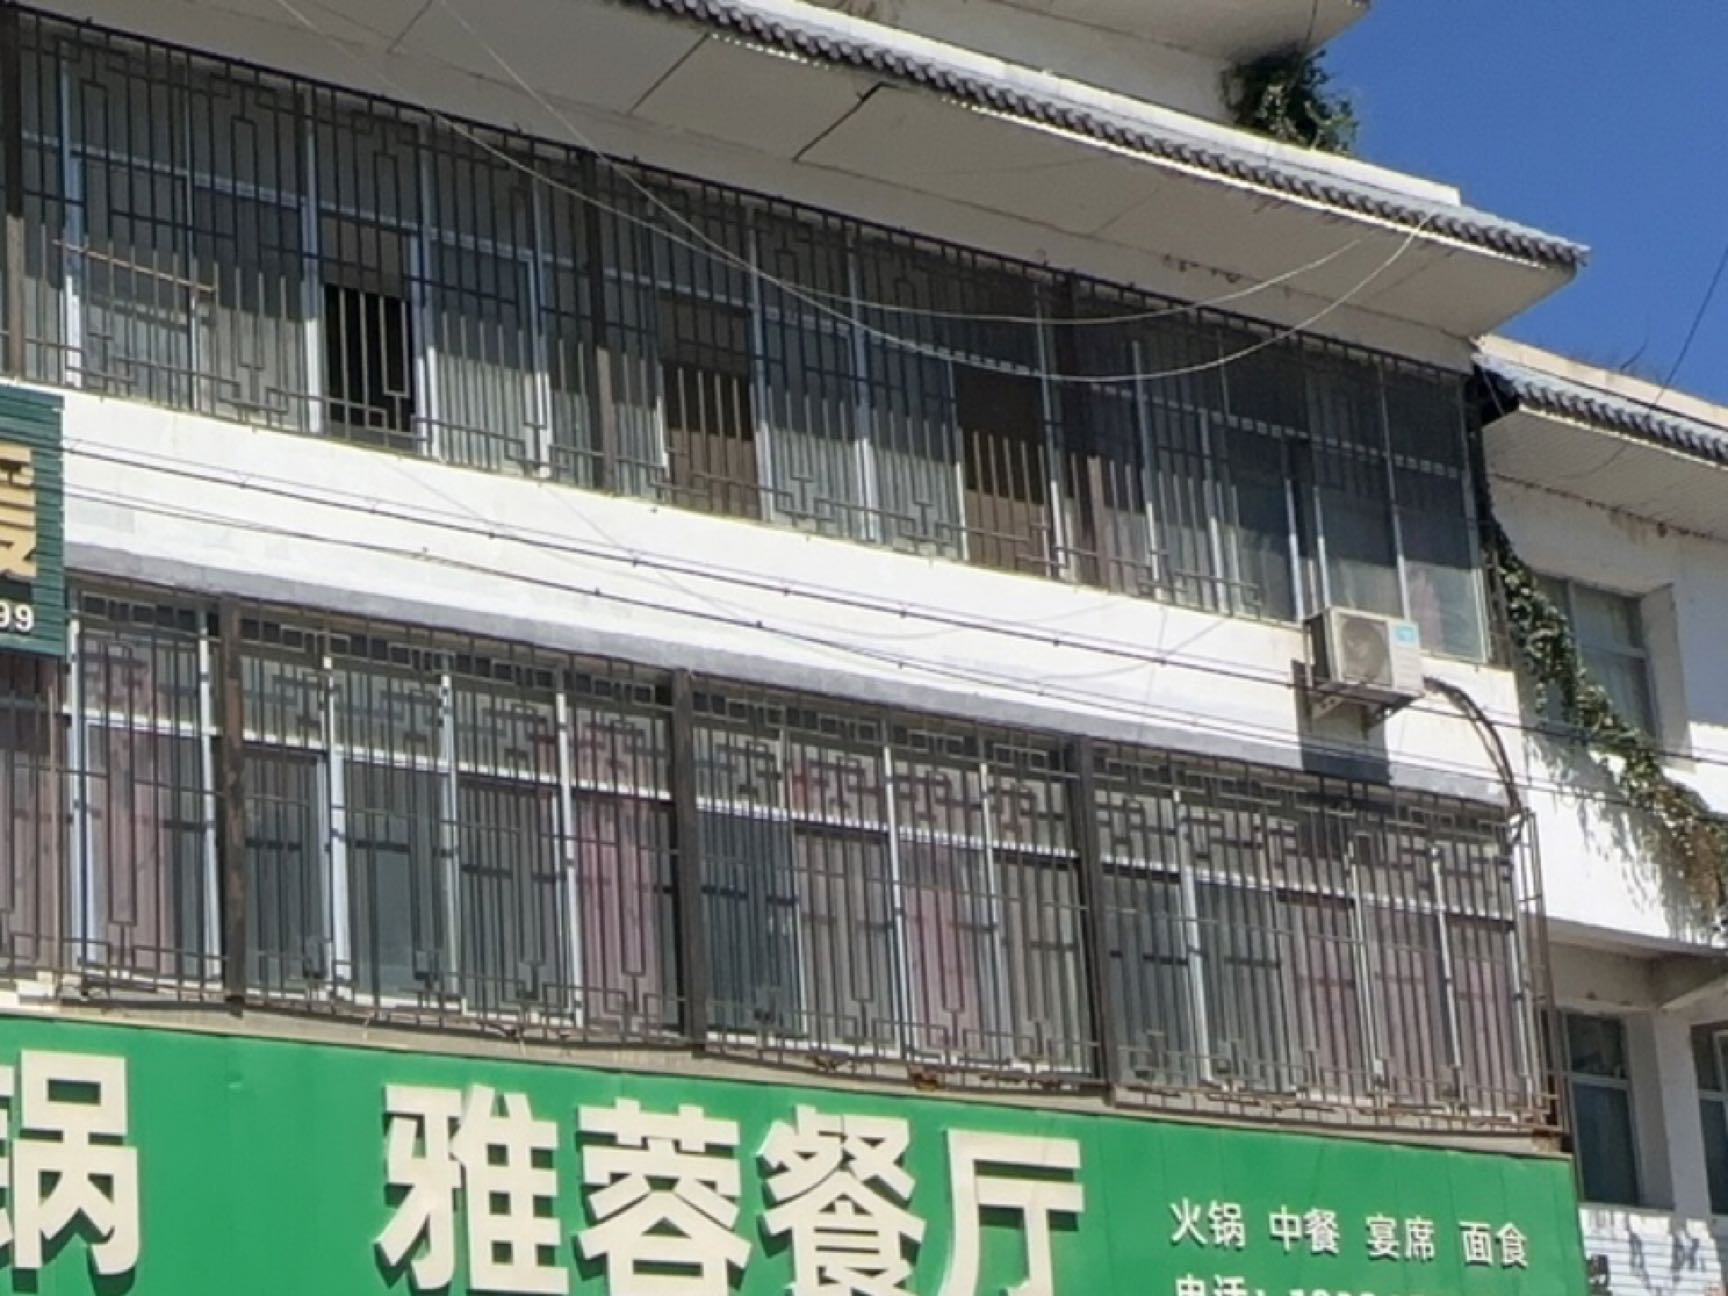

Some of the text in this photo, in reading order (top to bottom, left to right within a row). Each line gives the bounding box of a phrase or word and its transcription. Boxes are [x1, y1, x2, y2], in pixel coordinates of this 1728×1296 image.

[1170, 1197, 1529, 1269] 火锅 中餐 宴席 面食
